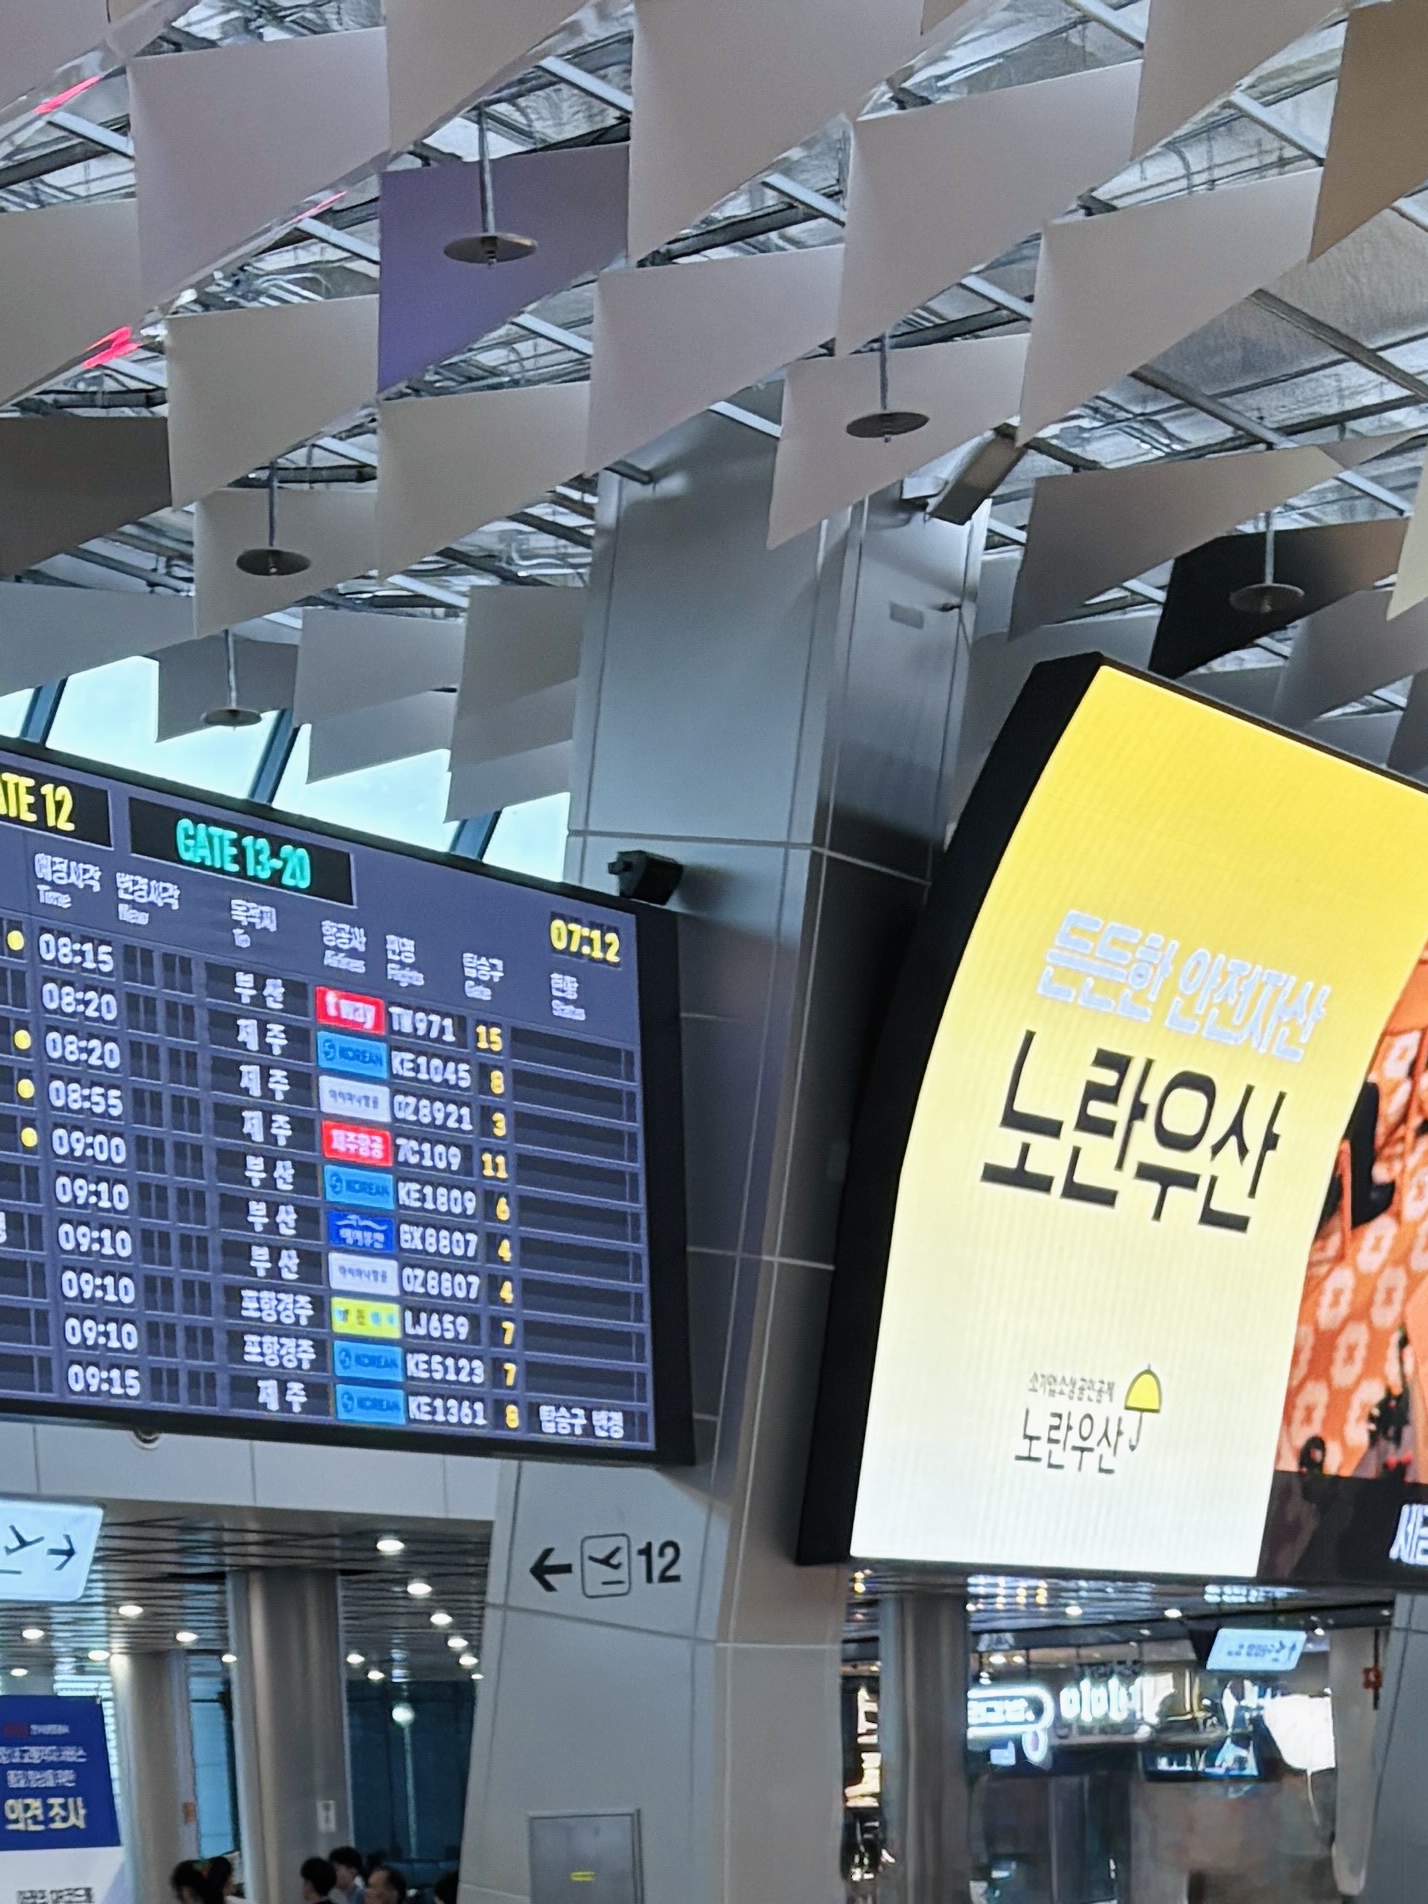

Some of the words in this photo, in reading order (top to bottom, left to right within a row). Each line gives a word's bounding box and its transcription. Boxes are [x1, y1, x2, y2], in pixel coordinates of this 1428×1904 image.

[40, 783, 75, 832] 12
[176, 818, 240, 873] GATE
[37, 885, 71, 909] Time
[39, 933, 114, 972] 08:15
[550, 918, 621, 965] 07:12
[41, 982, 118, 1021] 08:20
[1037, 909, 1180, 1023] 든든한
[1163, 947, 1333, 1063] 안전자산
[389, 1006, 456, 1042] TW971
[476, 1025, 503, 1052] 15
[45, 1031, 121, 1069] 08:20
[391, 1050, 472, 1088] KE1045
[490, 1069, 505, 1095] 8
[48, 1080, 123, 1117] 08:55
[393, 1094, 474, 1131] OZ8921
[492, 1112, 507, 1137] 3
[980, 1028, 1288, 1235] 노란우산
[51, 1128, 126, 1165] 09:00
[395, 1137, 462, 1171] 7C109
[481, 1152, 509, 1179] 11
[55, 1175, 130, 1211] 09:10
[397, 1180, 477, 1216] KE1809
[495, 1195, 511, 1222] 6
[57, 1222, 132, 1258] 09:10
[497, 1238, 512, 1263] 4
[61, 1270, 136, 1304] 09:10
[401, 1266, 481, 1300] OZ8807
[499, 1280, 514, 1304] 4
[240, 1288, 316, 1327] 포항경주
[404, 1309, 470, 1340] LJ659
[64, 1317, 139, 1351] 09:10
[501, 1320, 516, 1346] 7
[243, 1333, 318, 1371] 포항경주
[406, 1352, 486, 1384] KE5123
[67, 1364, 141, 1397] 09:15
[503, 1362, 517, 1387] 7
[408, 1395, 488, 1426] KE1361
[505, 1404, 520, 1429] 8
[537, 1404, 588, 1437] 탑승구
[1014, 1406, 1125, 1475] 노란우산
[636, 1539, 682, 1584] 12
[4, 1798, 47, 1832] 의견
[45, 1796, 88, 1829] 조사
